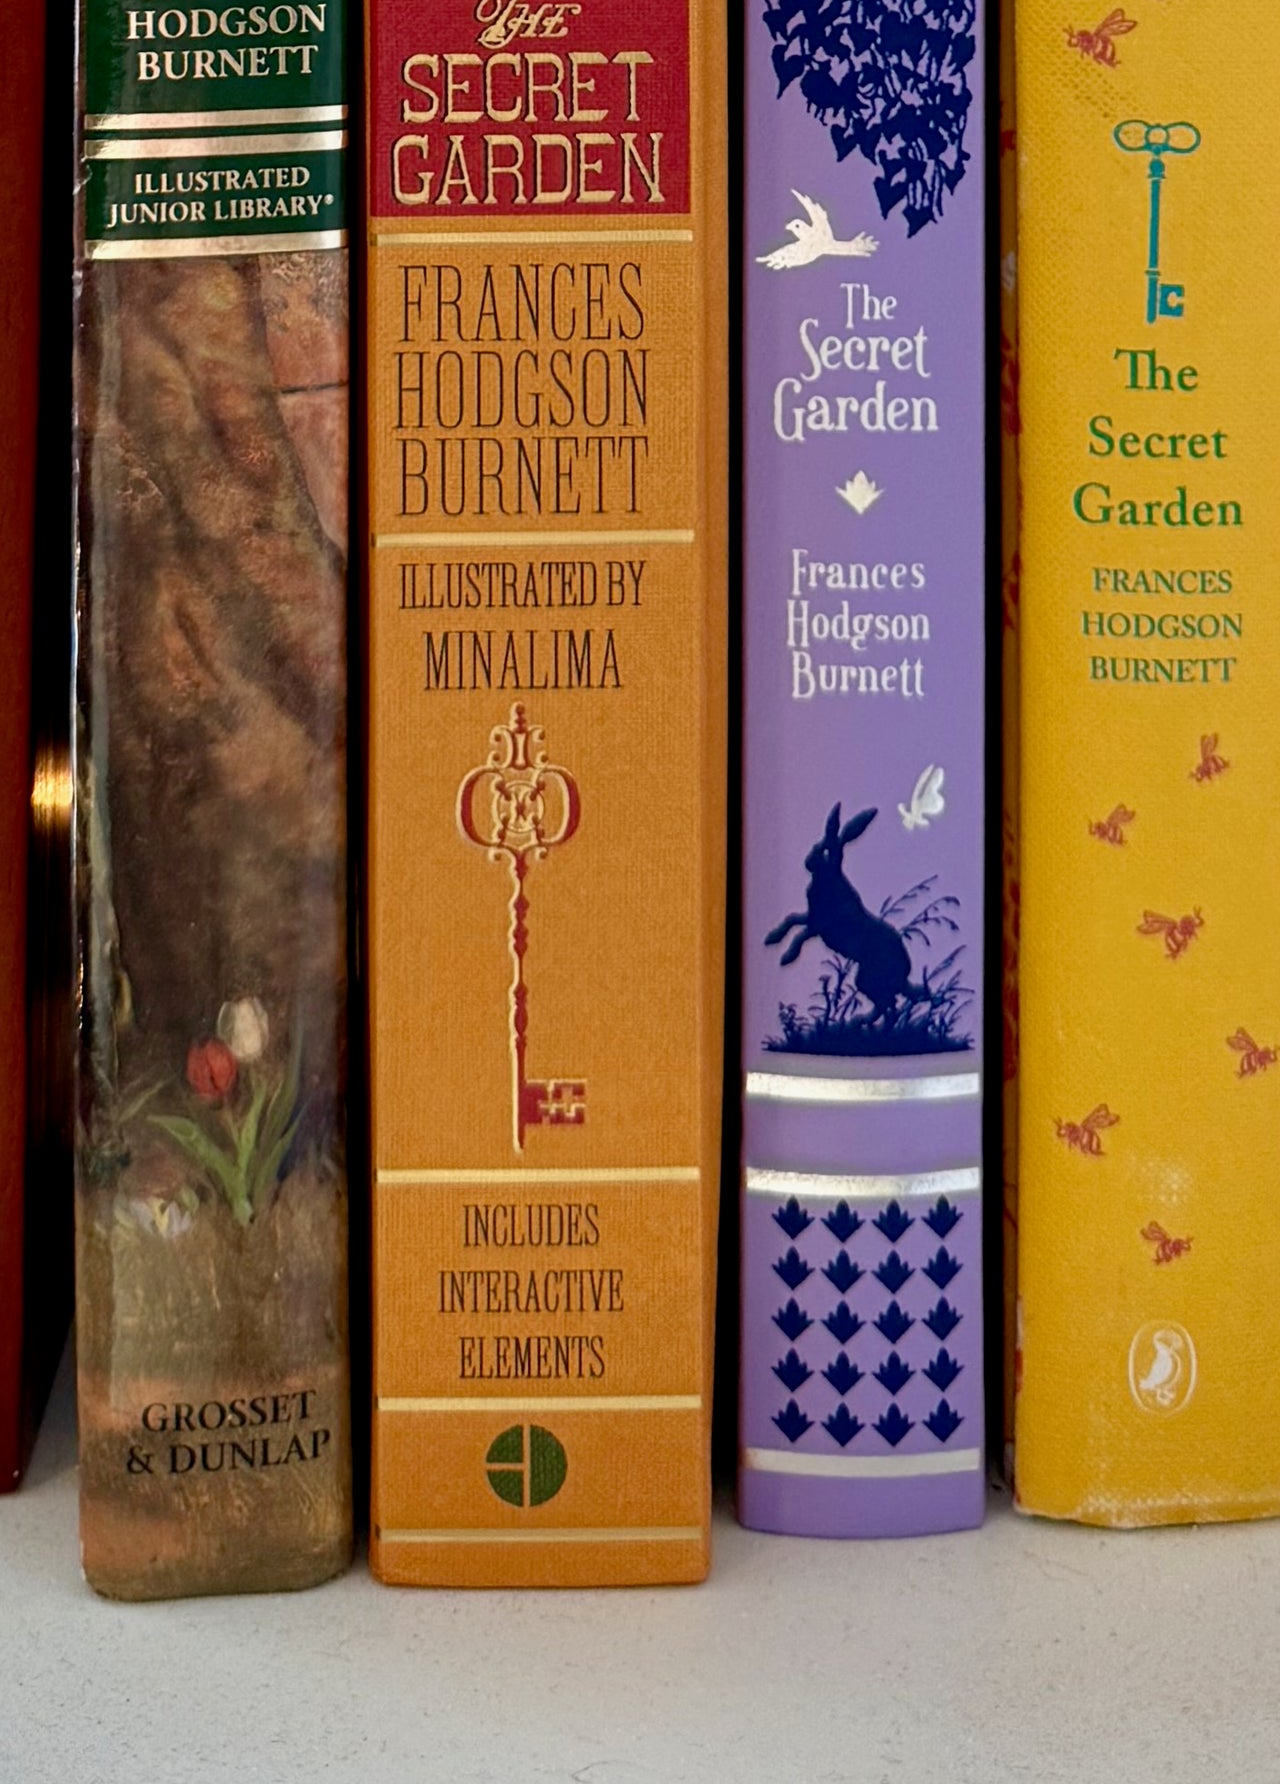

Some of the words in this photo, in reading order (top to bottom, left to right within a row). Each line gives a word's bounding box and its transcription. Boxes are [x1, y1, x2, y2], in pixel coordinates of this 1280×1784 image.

[127, 4, 326, 40] HODGSON
[138, 45, 318, 81] BURNETT
[402, 51, 654, 124] SECRET
[135, 167, 310, 194] ILLUSTRATED
[392, 132, 665, 205] GARDEN
[106, 201, 206, 228] JUNIOR
[398, 262, 644, 343] FRANCES
[840, 282, 897, 329] The
[799, 318, 932, 382] Secret
[1113, 348, 1199, 392] The
[393, 348, 651, 430] HODGSON
[773, 377, 939, 443] Garden
[1088, 415, 1228, 459] Secret
[396, 436, 649, 517] BURNETT
[1073, 481, 1244, 527] Garden
[398, 561, 597, 609] ILLUSTRATED
[606, 560, 647, 607] BY
[791, 548, 926, 596] Frances
[1092, 567, 1233, 595] FRANCES
[786, 599, 930, 650] Hodgson
[1081, 611, 1243, 638] HODGSON
[423, 628, 624, 691] MINALIMA
[791, 650, 926, 700] Burnett
[1090, 656, 1236, 683] BURNETT
[463, 1203, 600, 1248] INCLUDES
[438, 1269, 624, 1314] INTERACTIVE
[459, 1335, 605, 1380] ELEMENTS
[142, 1390, 317, 1432] GROSSET
[126, 1445, 154, 1474] &
[169, 1429, 331, 1474] DUNLAP
